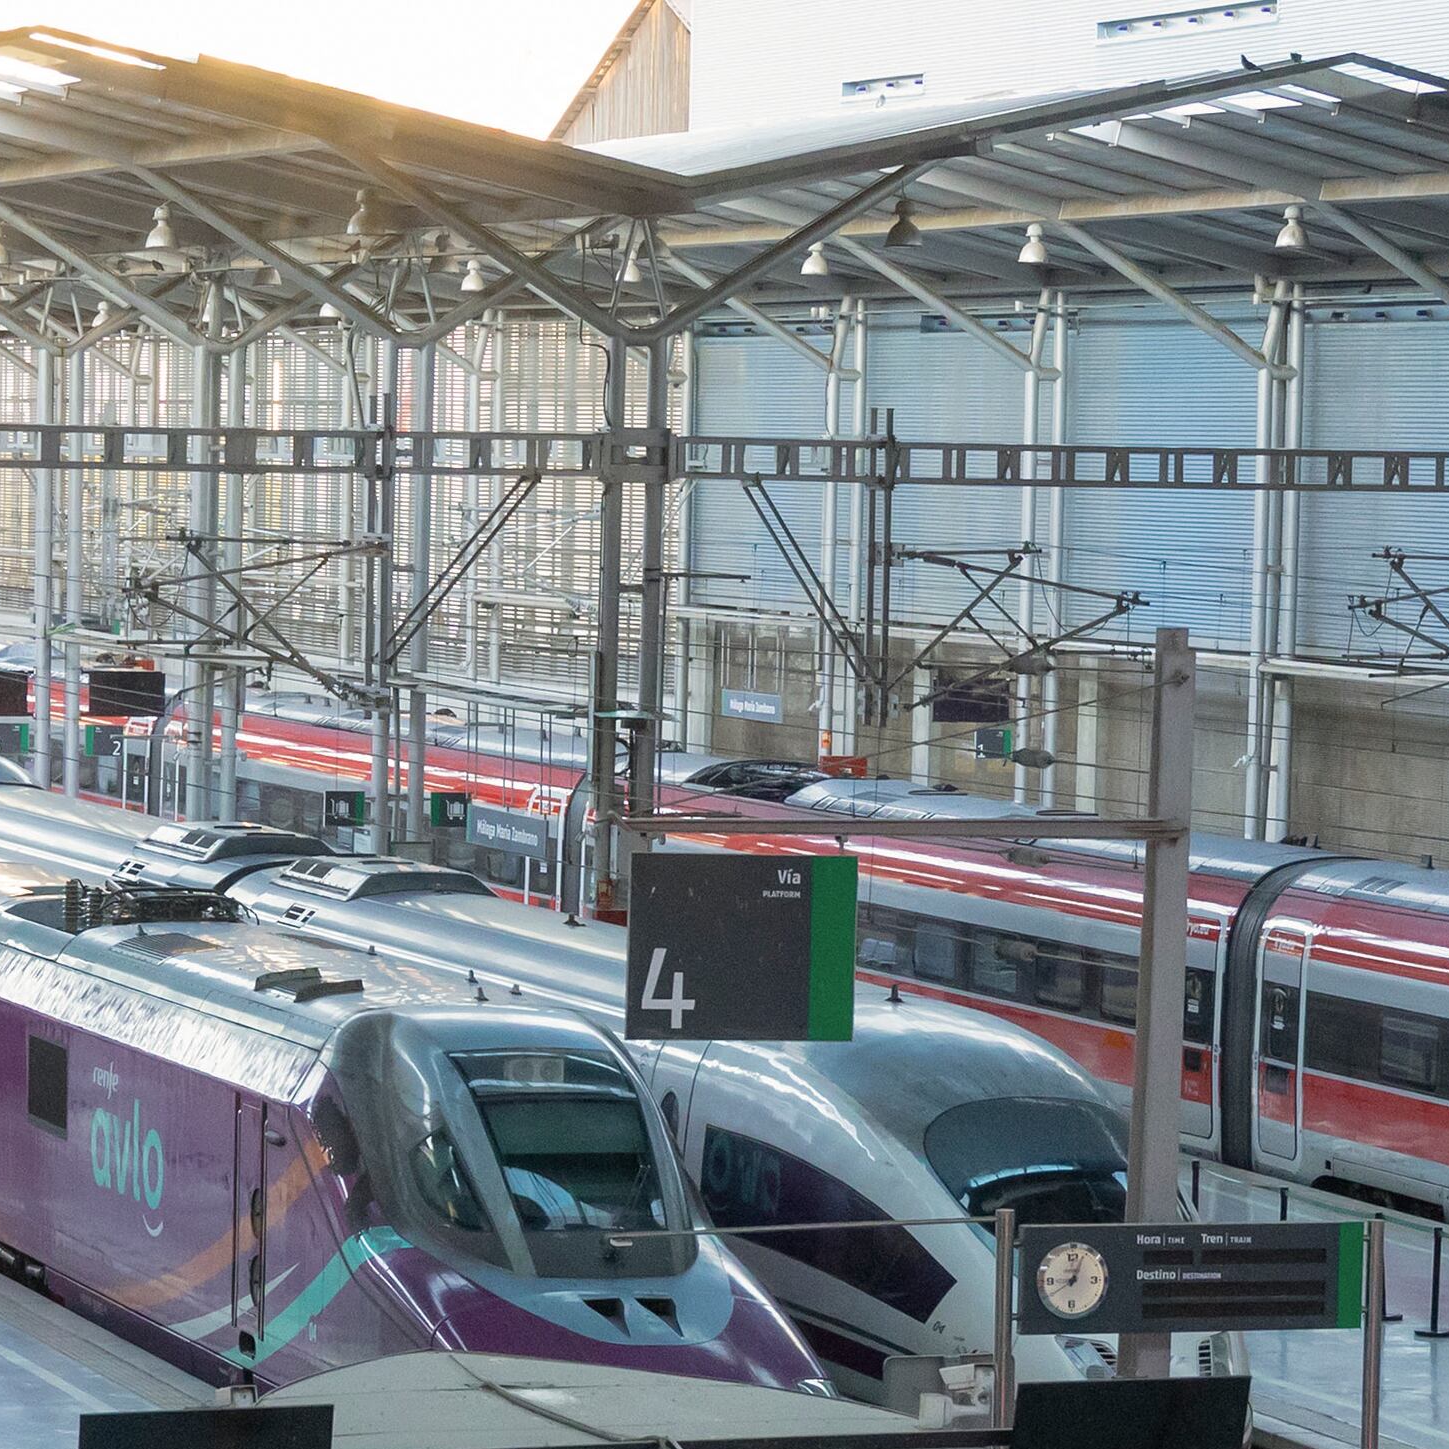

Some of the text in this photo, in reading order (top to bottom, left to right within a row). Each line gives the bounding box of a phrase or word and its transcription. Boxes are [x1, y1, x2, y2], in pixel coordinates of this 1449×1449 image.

[112, 740, 122, 756] 2
[777, 869, 801, 884] Vía
[762, 890, 801, 898] PLATFORM
[641, 947, 696, 1029] 4
[93, 1061, 119, 1100] renfe
[90, 1098, 165, 1210] avlo
[1137, 1234, 1161, 1245] Hora
[1201, 1233, 1223, 1244] Tren
[1067, 1253, 1079, 1262] 12
[1136, 1269, 1221, 1280] Destino DESTINATION
[1046, 1276, 1054, 1285] 9
[1090, 1276, 1098, 1285] 3
[1068, 1300, 1076, 1308] 6
